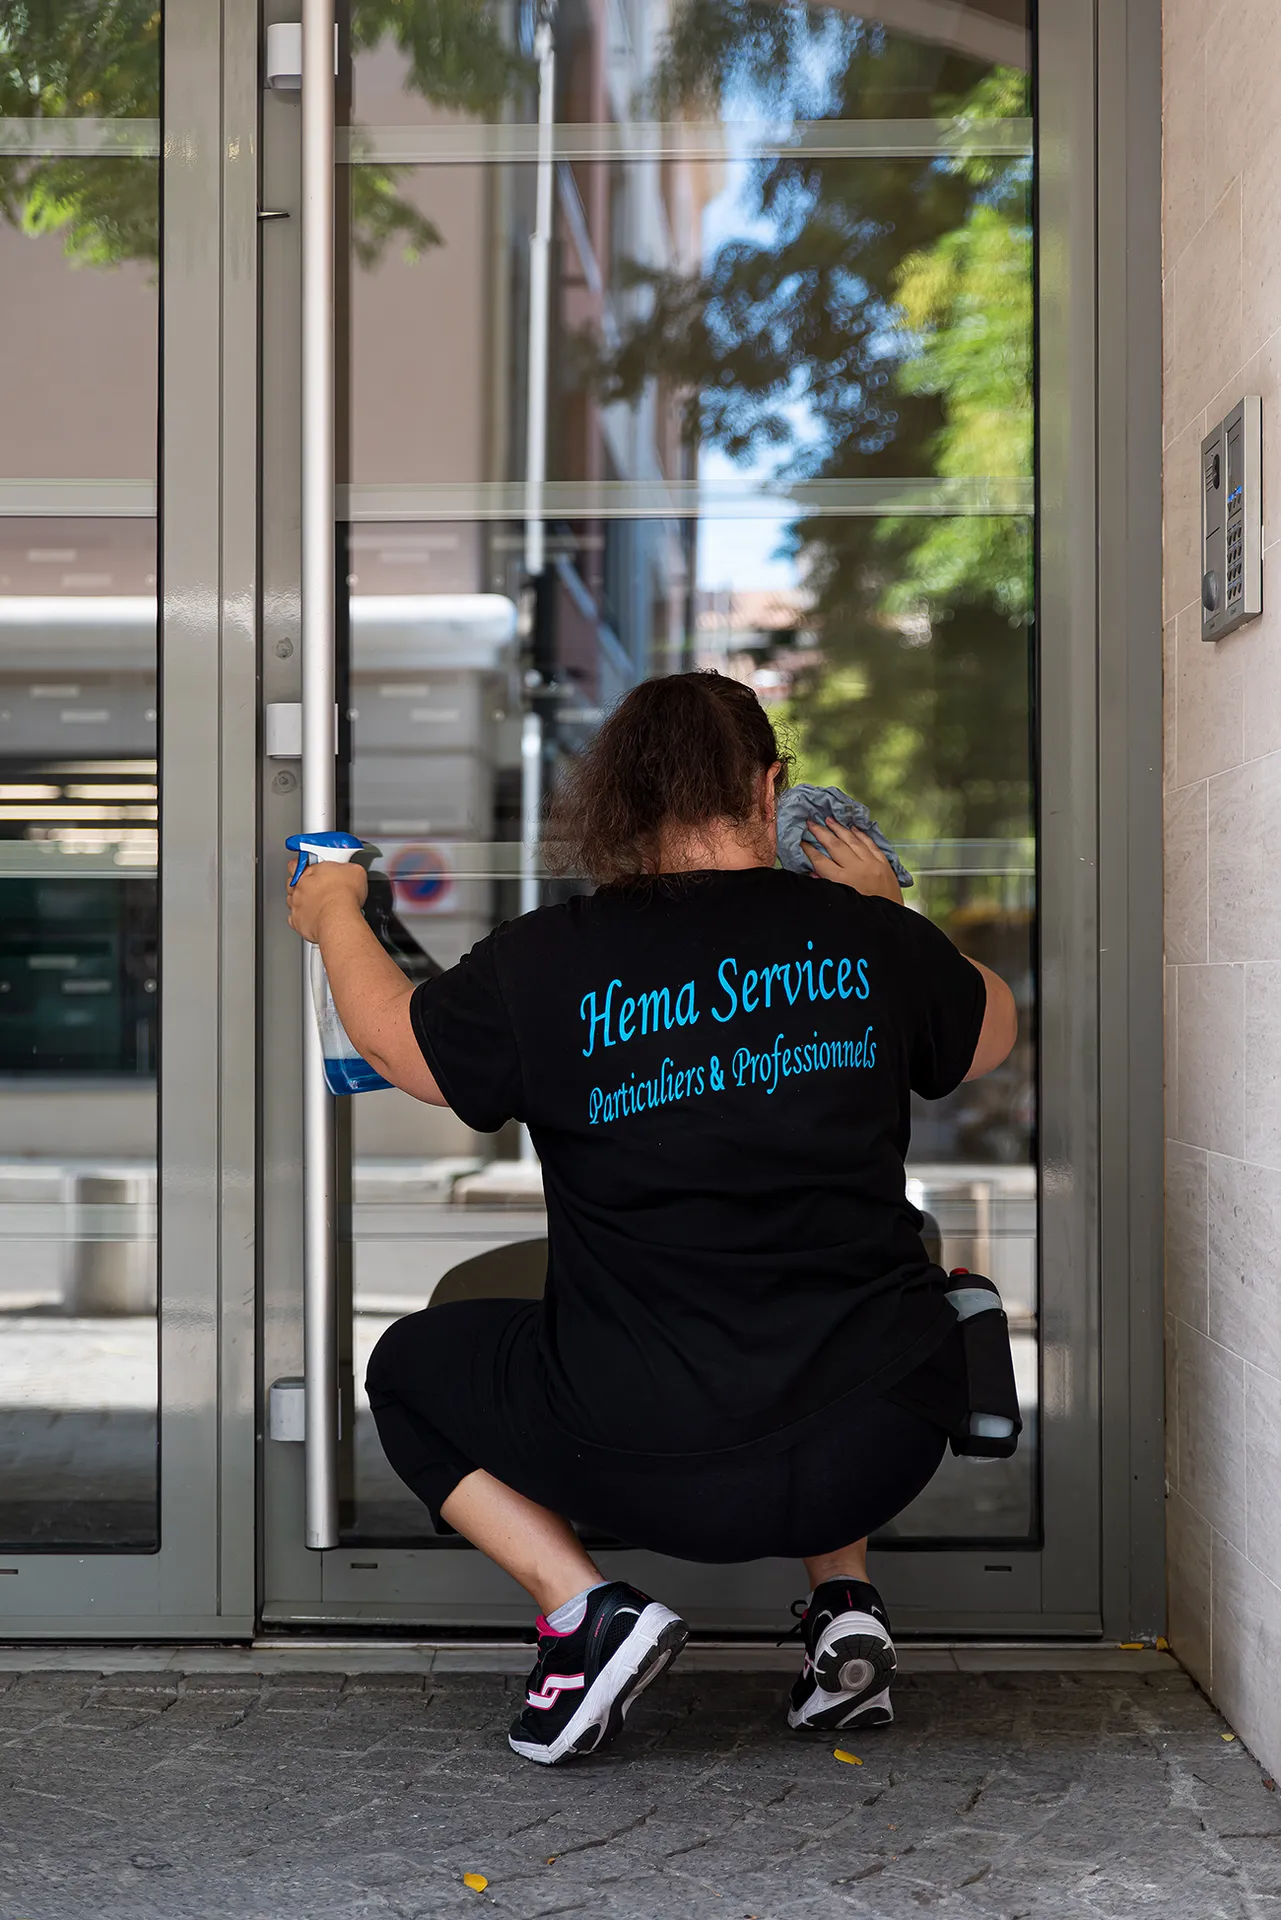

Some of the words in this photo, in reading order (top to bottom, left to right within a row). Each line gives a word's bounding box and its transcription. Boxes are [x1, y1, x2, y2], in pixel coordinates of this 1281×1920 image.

[580, 979, 700, 1057] Hema
[711, 940, 870, 1022] Services
[589, 1057, 705, 1124] Particuliers
[710, 1055, 725, 1091] &
[732, 1026, 876, 1095] Professionnels
